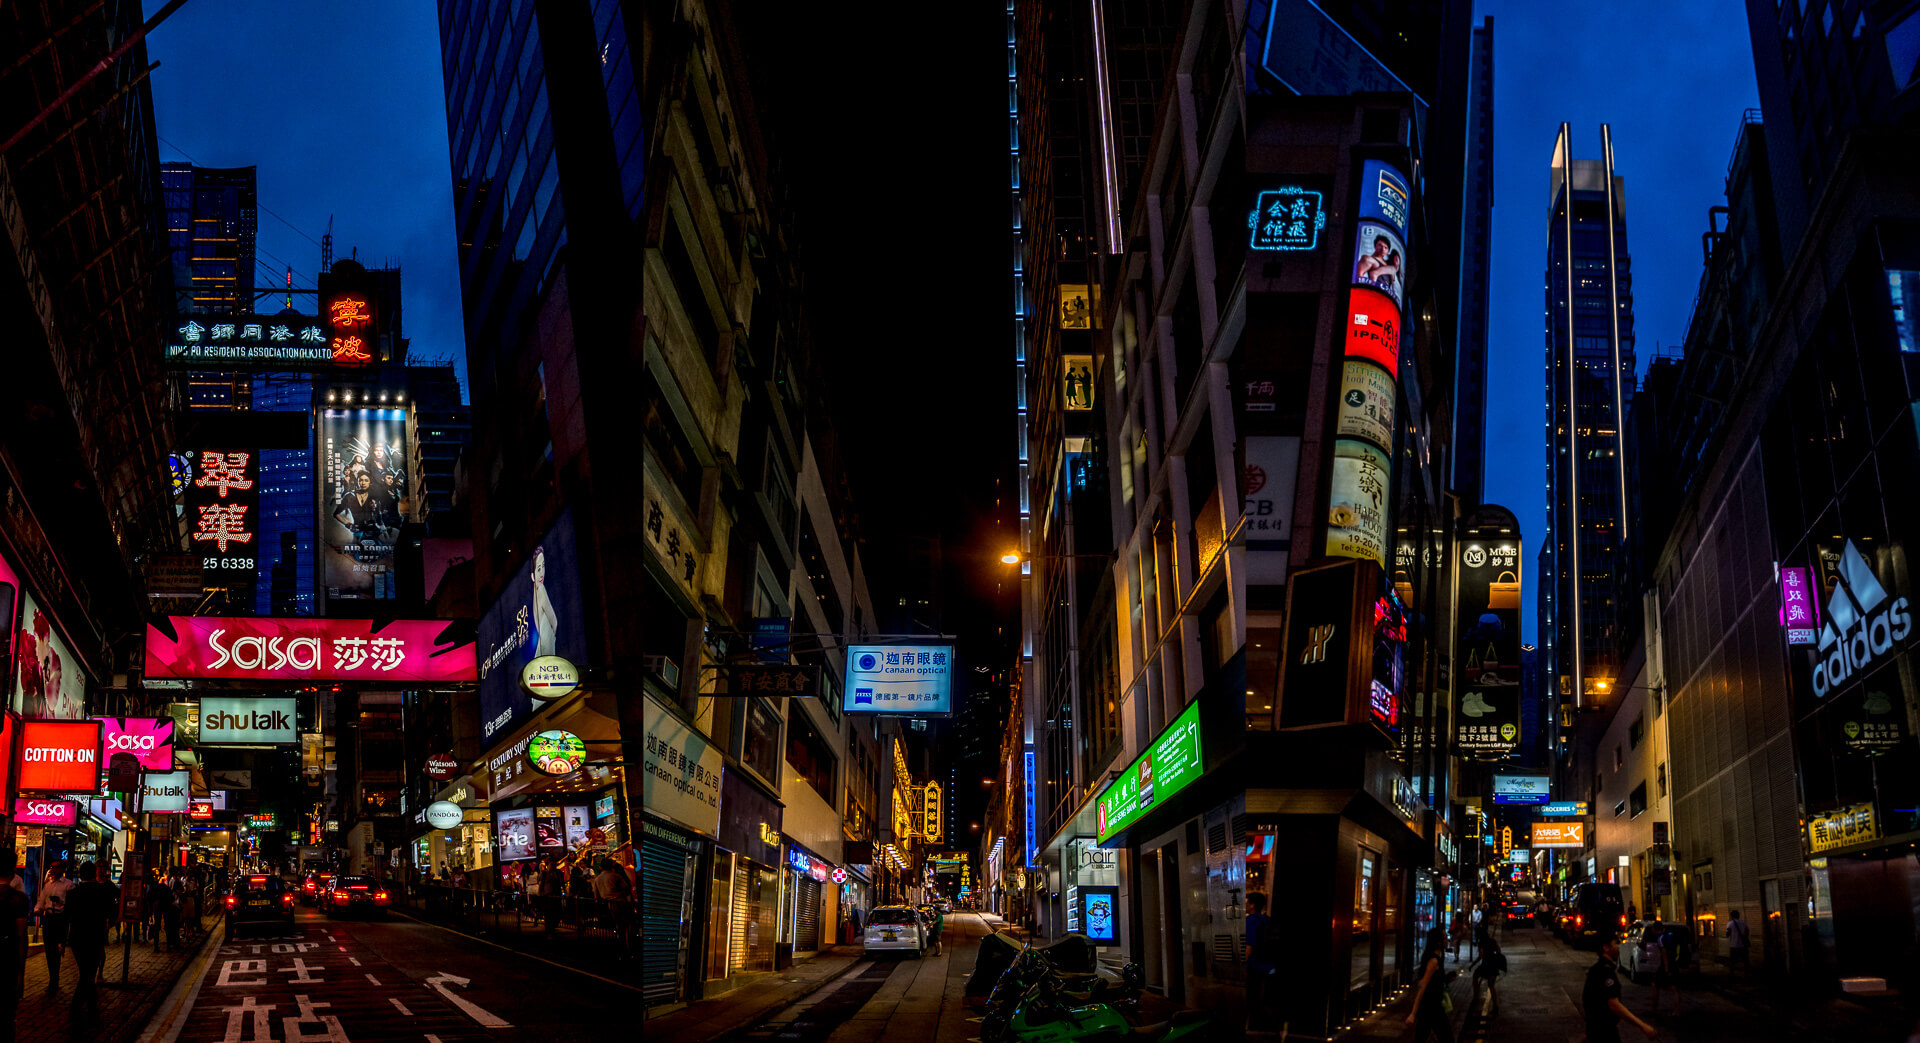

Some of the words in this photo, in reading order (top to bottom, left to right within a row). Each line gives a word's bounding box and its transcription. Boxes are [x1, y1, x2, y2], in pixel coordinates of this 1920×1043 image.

[204, 345, 246, 358] RESIDENTS
[247, 346, 299, 359] ASSOCIATION
[1360, 428, 1381, 442] 2523
[194, 451, 254, 553] 翠華
[1353, 503, 1382, 523] HAPPY
[1363, 517, 1383, 536] FOOT
[1340, 543, 1354, 553] Tel:
[1489, 548, 1517, 557] MUSE
[221, 557, 255, 570] 6338
[1491, 556, 1515, 567] 妙思
[332, 636, 406, 672] 莎莎
[1812, 595, 1913, 699] adidas
[885, 651, 947, 666] 迦南眼鏡
[884, 666, 915, 674] canaan
[916, 666, 947, 676] optical
[205, 710, 249, 730] shu
[251, 710, 291, 731] talk
[428, 760, 458, 768] Watson's
[490, 750, 514, 771] CENTURY
[646, 731, 720, 793] 迦南眼鏡有限公司
[644, 759, 672, 784] canaan
[673, 775, 696, 797] optical
[164, 785, 185, 797] talk
[1026, 757, 1034, 845] STANLEY
[1081, 847, 1113, 863] hair
[217, 942, 320, 956] STOP
[214, 957, 326, 987] 巴士
